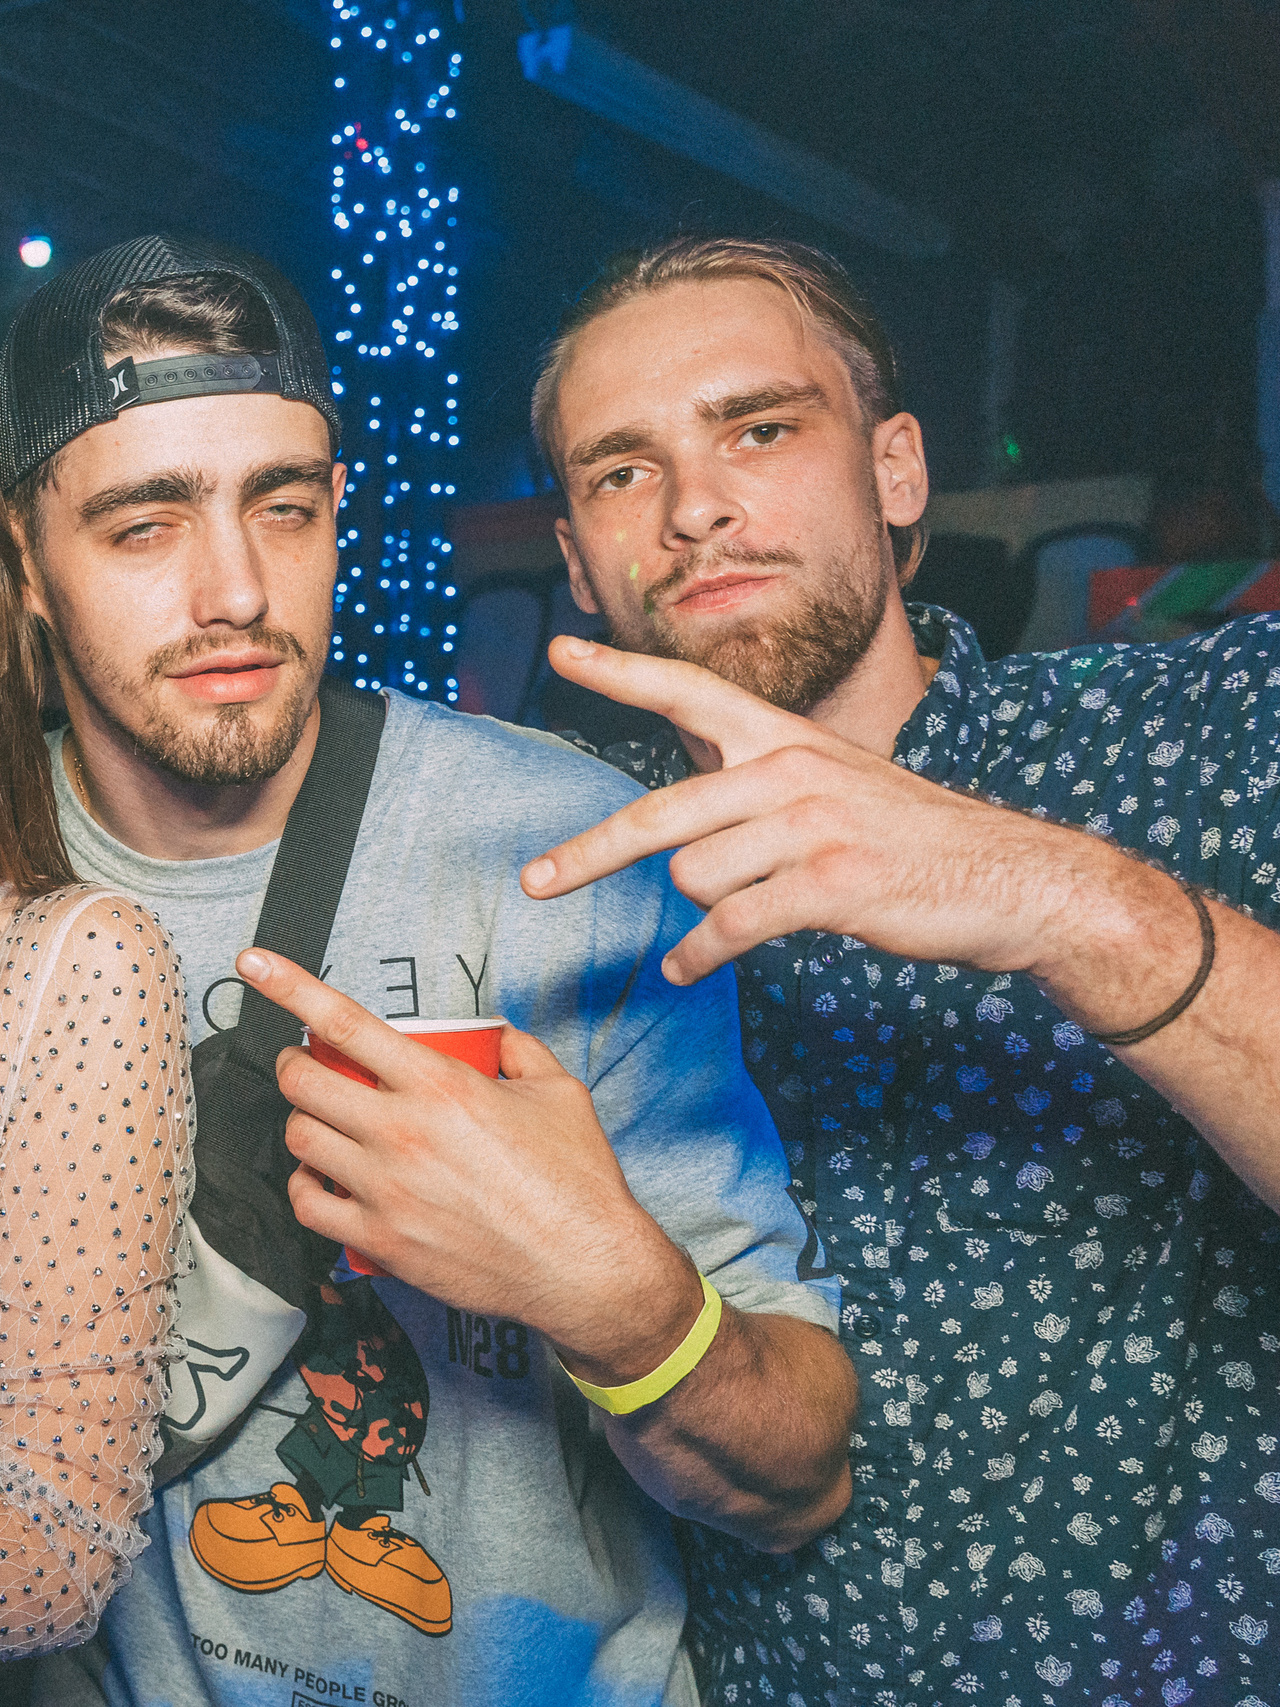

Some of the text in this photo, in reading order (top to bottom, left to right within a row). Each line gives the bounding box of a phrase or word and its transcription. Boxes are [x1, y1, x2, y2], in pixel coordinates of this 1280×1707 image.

[191, 1633, 228, 1660] TOO
[234, 1649, 289, 1678] MANY
[294, 1667, 366, 1702] PEOPLE
